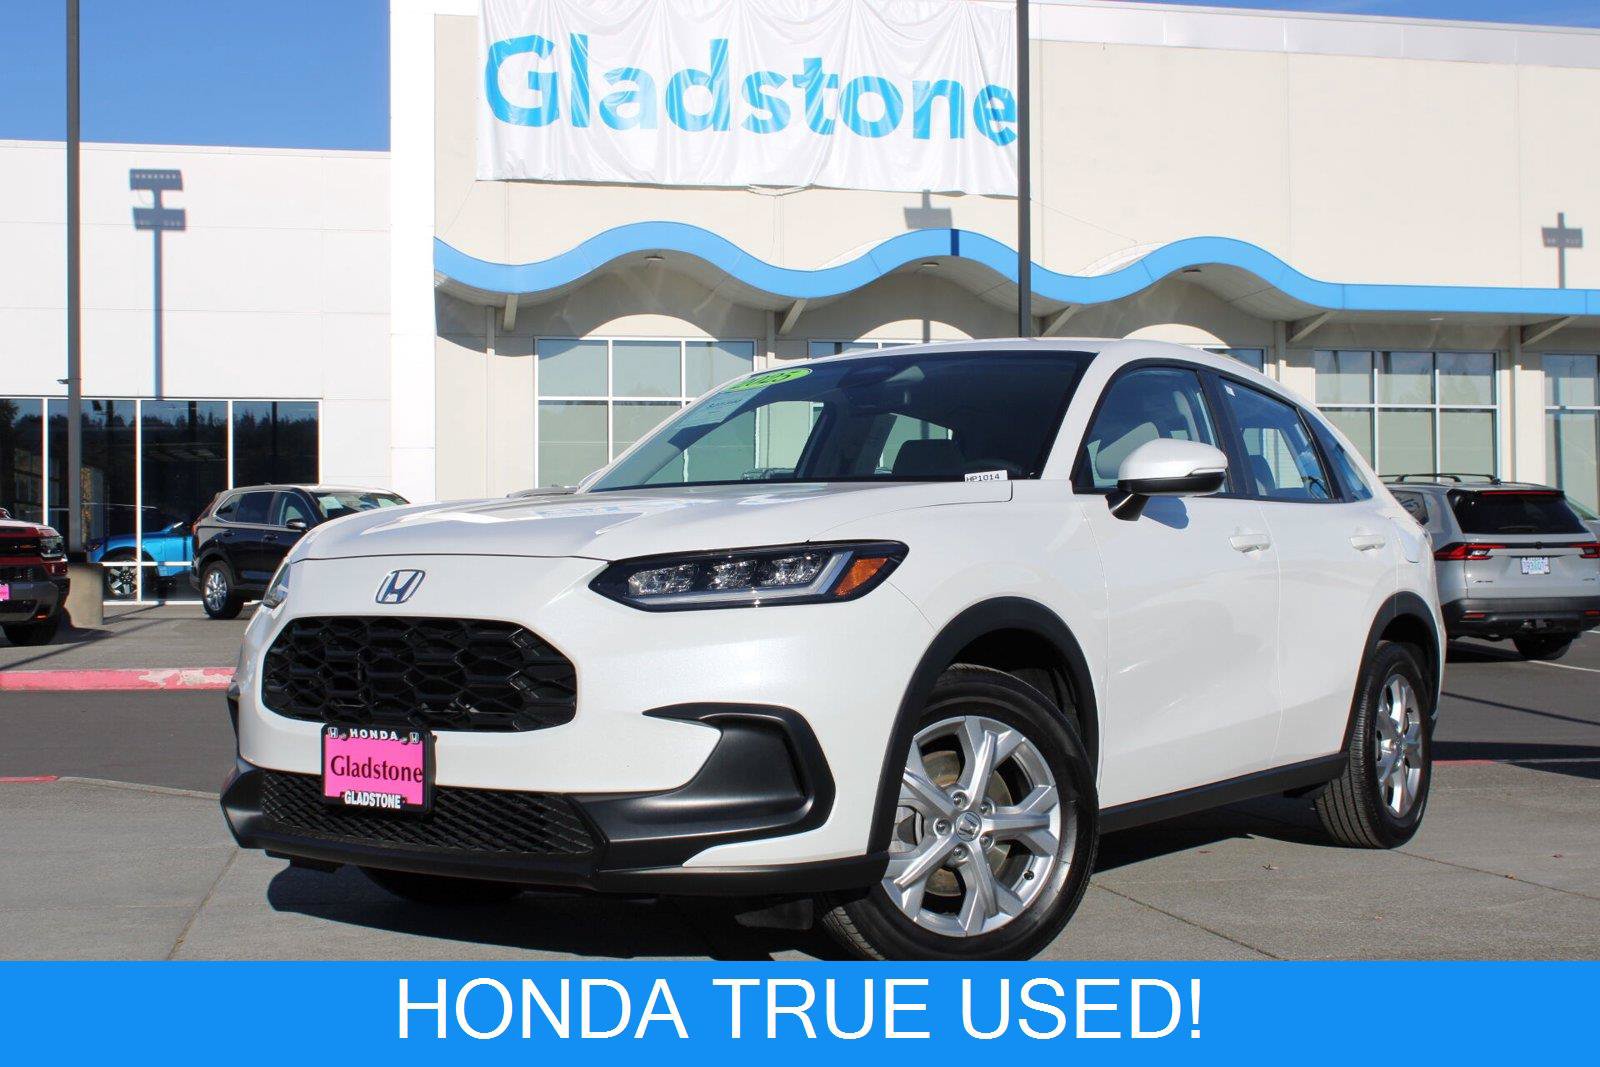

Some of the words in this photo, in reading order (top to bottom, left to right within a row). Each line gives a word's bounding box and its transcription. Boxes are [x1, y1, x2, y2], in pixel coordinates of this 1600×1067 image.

[485, 34, 1017, 147] Gladstone
[350, 728, 398, 740] HONDA
[330, 755, 423, 783] Gladstone
[344, 790, 401, 809] GLADSTONE
